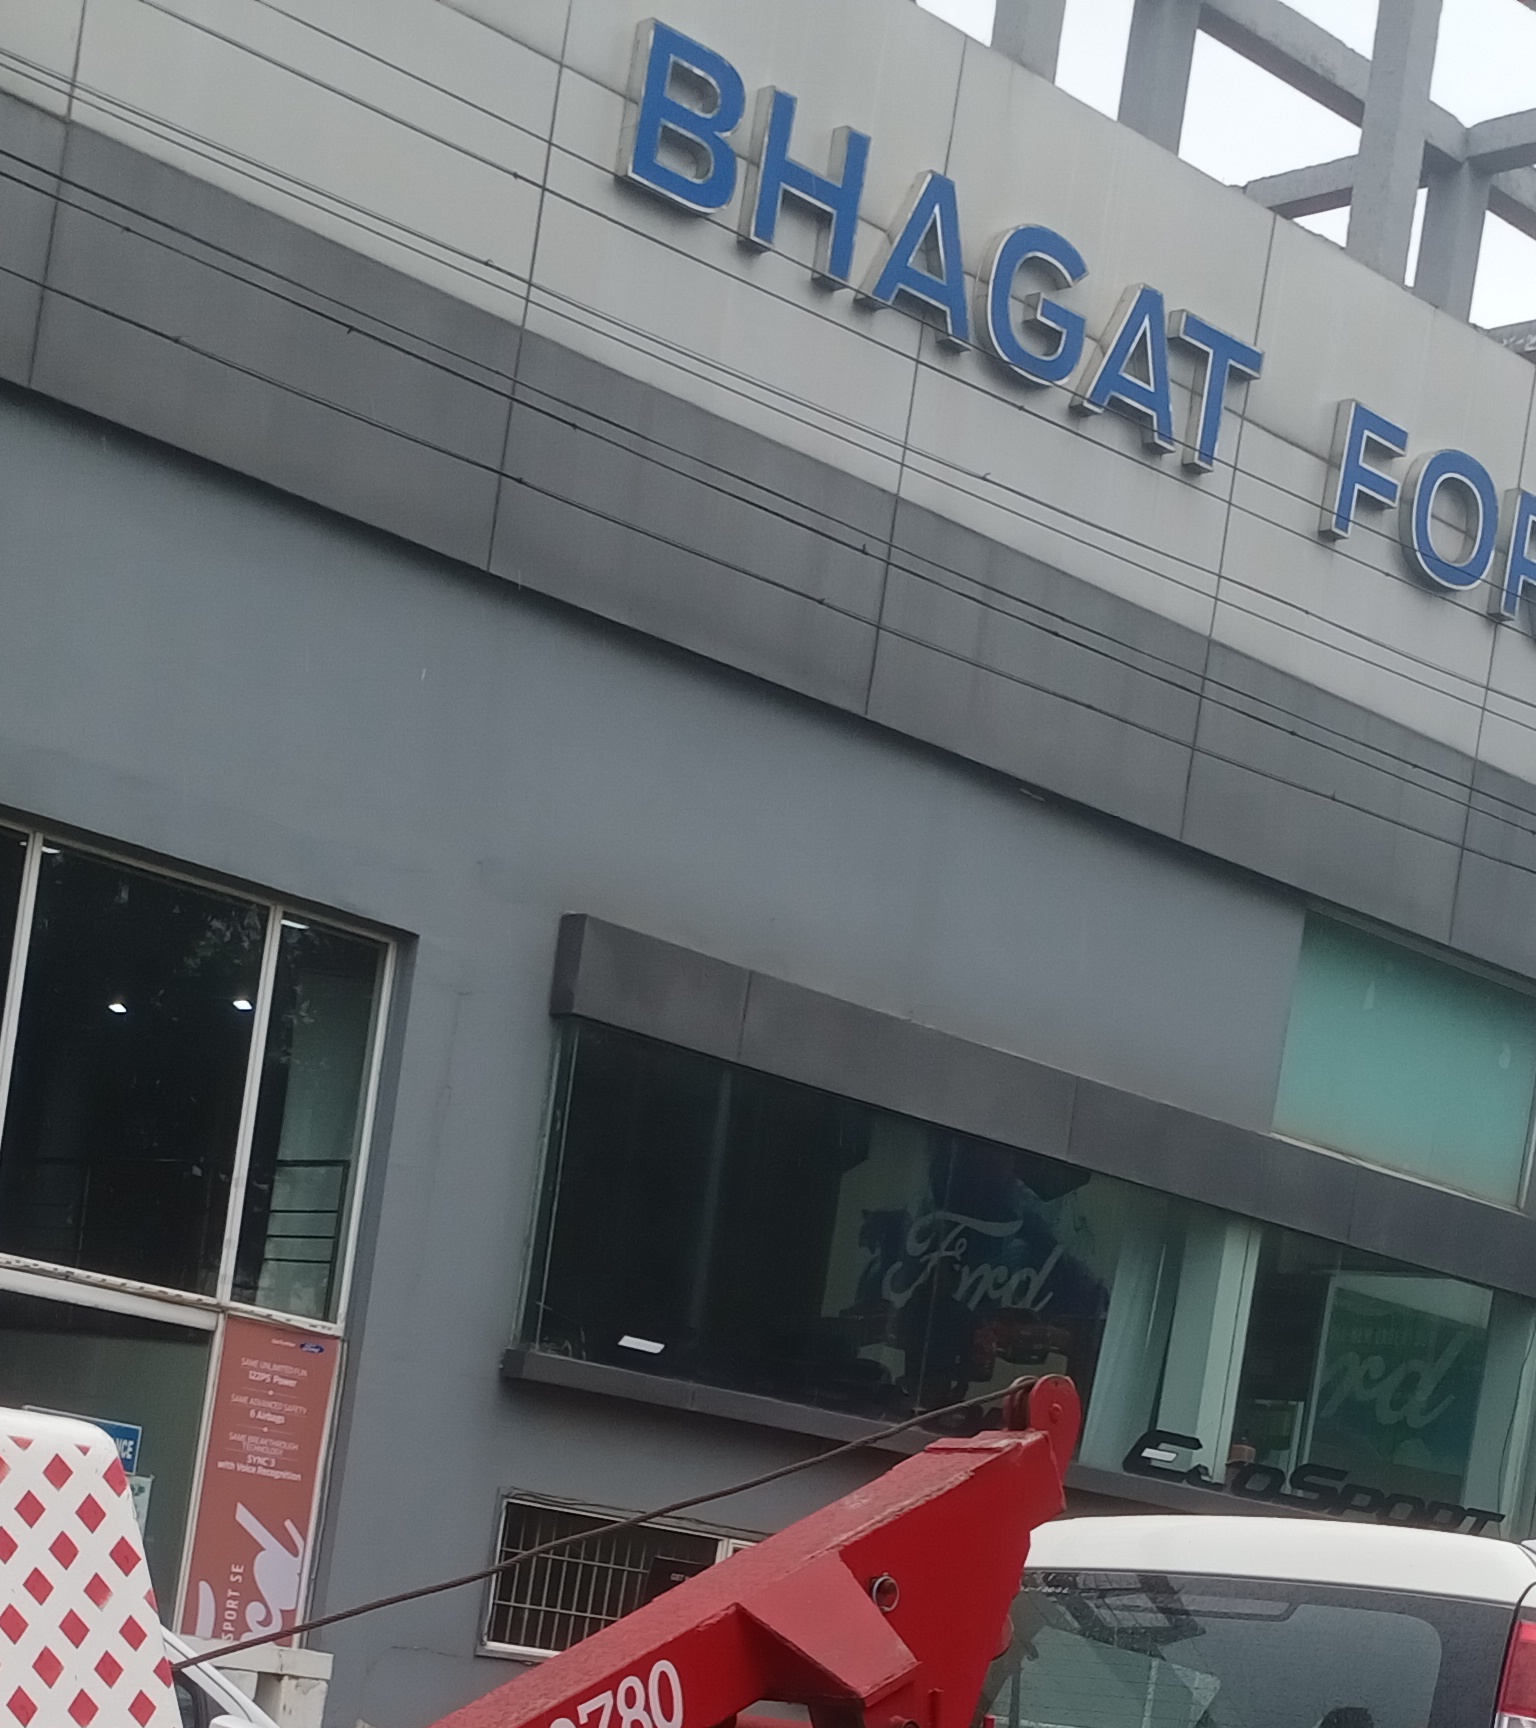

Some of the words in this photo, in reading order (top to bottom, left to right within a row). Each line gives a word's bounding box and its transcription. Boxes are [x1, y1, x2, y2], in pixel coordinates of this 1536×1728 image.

[615, 17, 1265, 473] BHAGAT
[272, 1375, 298, 1388] Power
[236, 1462, 257, 1475] Voice
[257, 1465, 302, 1482] Recognition
[230, 1563, 245, 1584] SE
